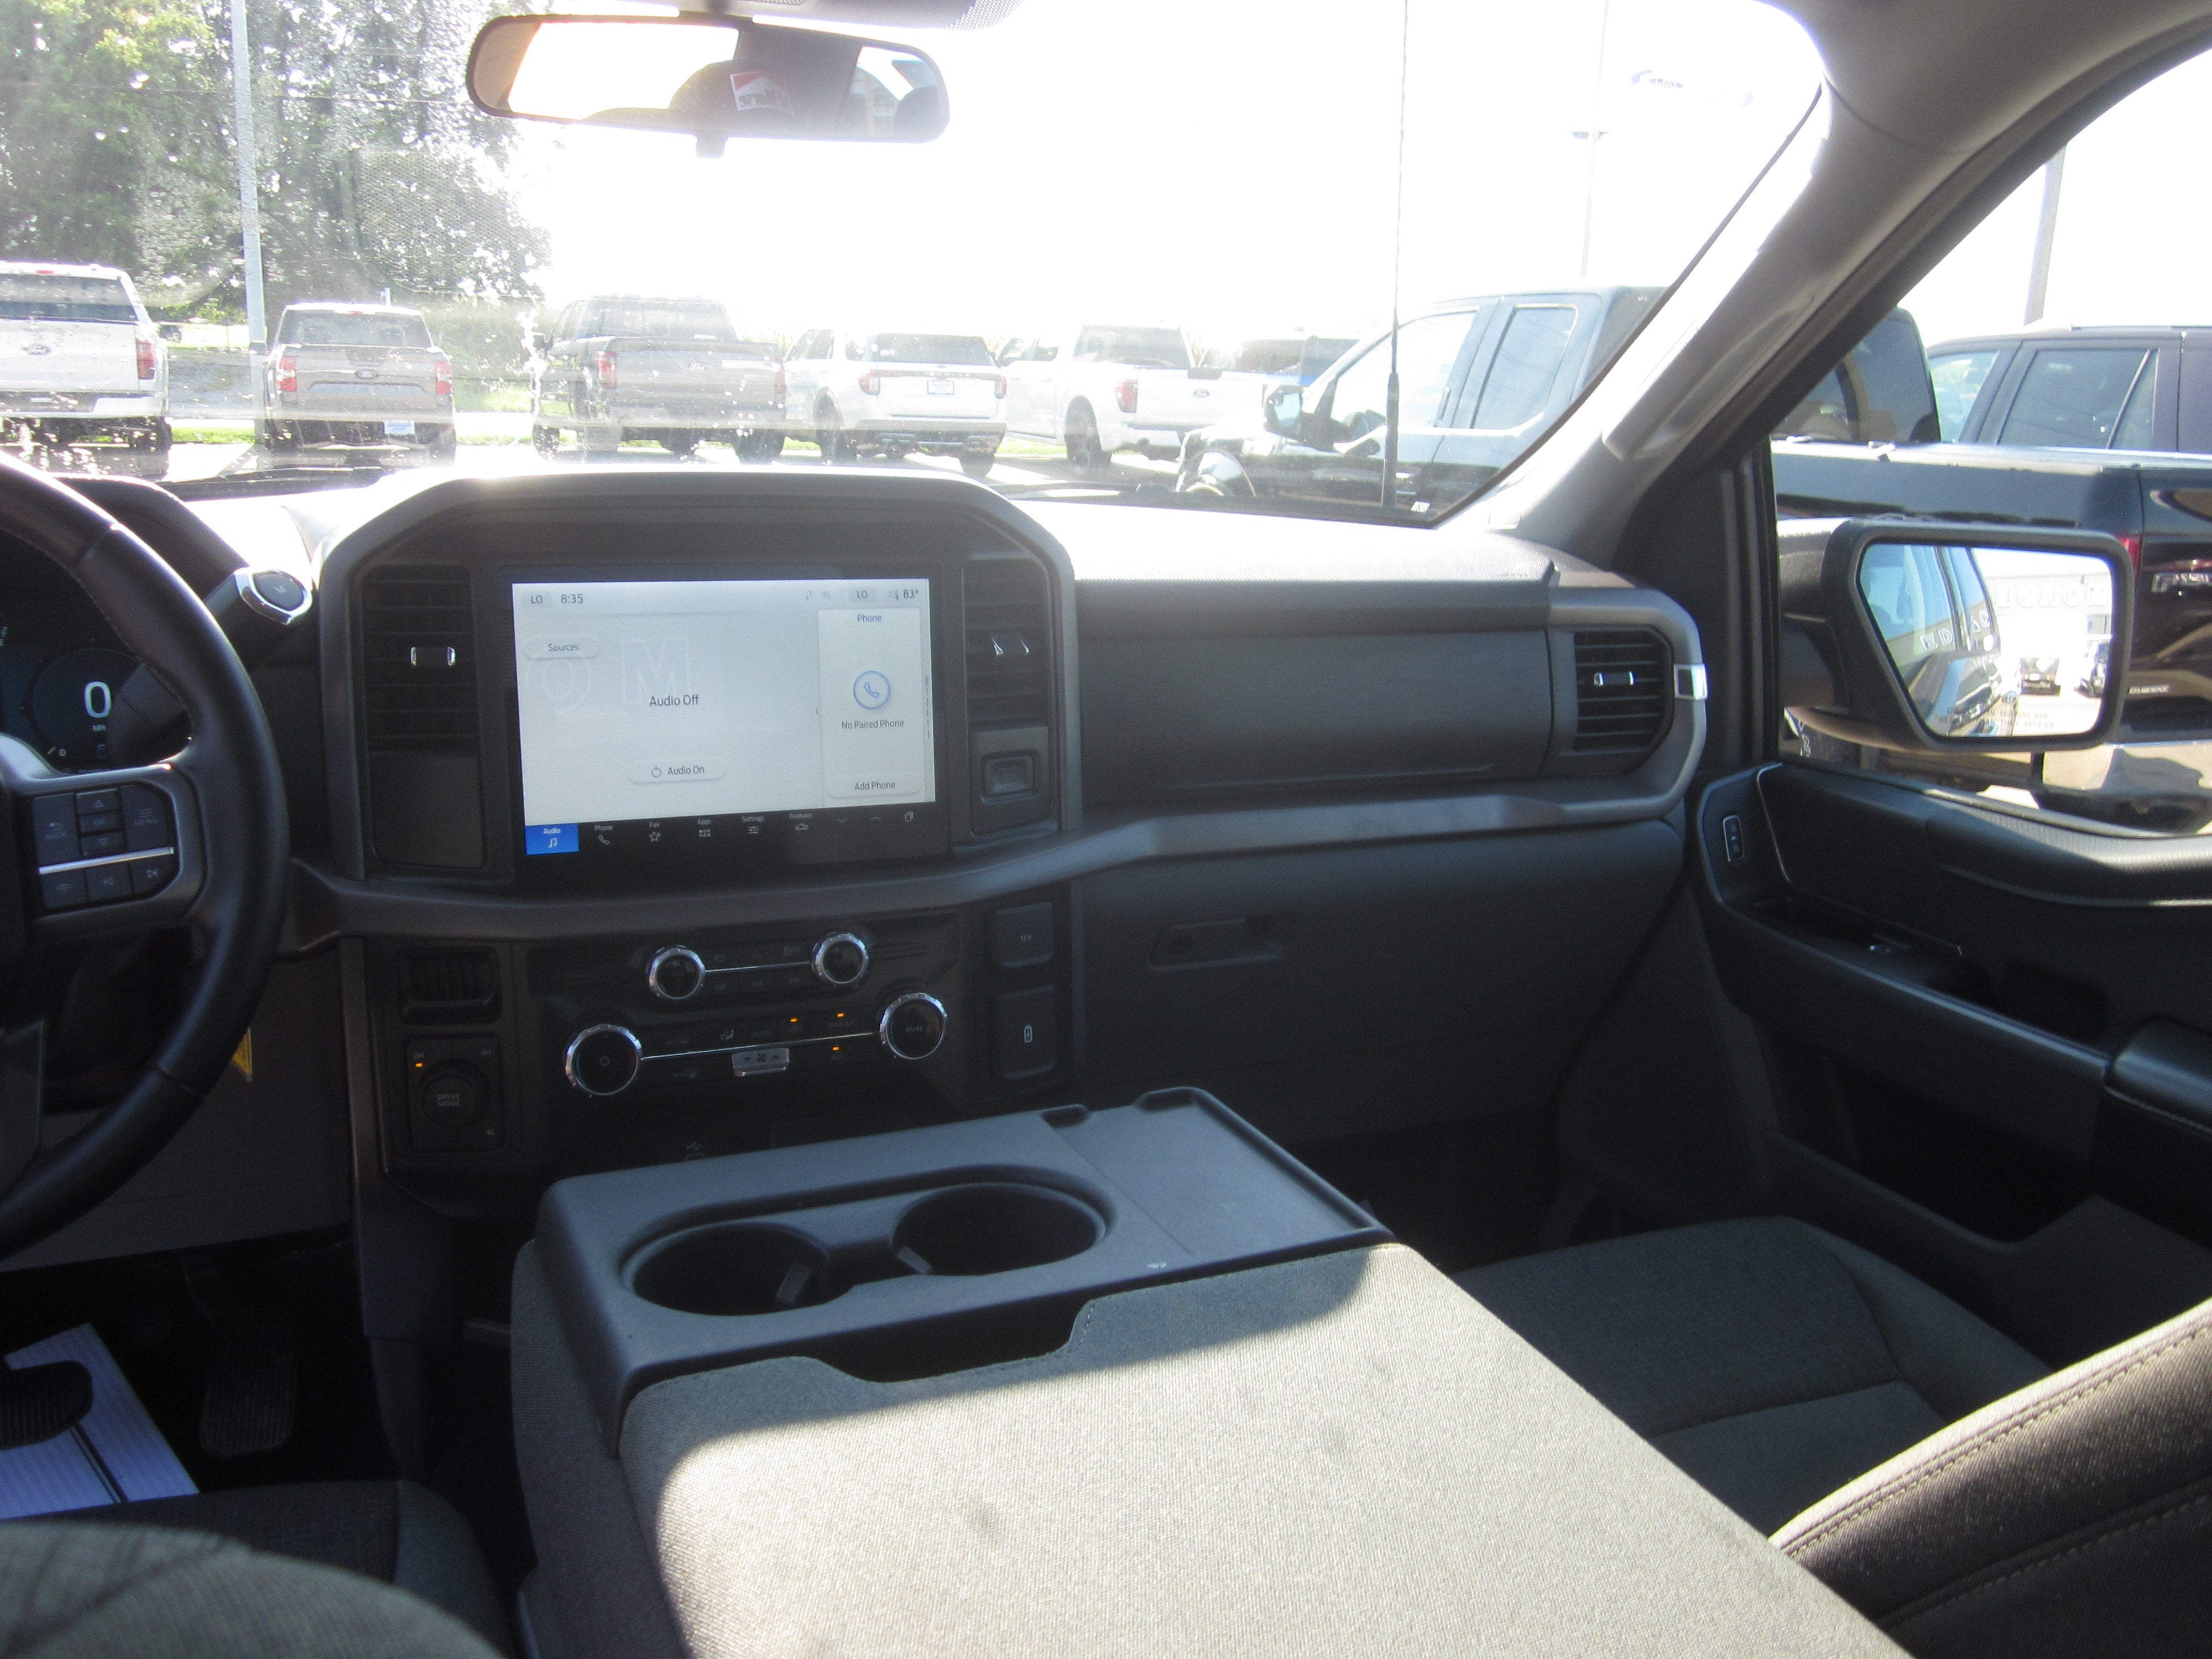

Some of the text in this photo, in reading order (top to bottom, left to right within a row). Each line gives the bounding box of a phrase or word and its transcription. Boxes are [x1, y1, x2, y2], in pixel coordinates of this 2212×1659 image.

[530, 593, 583, 604] LO 8:35
[857, 590, 868, 599] LO
[857, 614, 882, 623] Phone
[547, 643, 579, 652] Sources
[84, 681, 112, 718] 0
[649, 693, 700, 707] Audio Off
[2000, 709, 2030, 718] MIOR
[841, 719, 904, 729] No Paired Phone
[667, 765, 705, 775] Audio On
[854, 781, 895, 790] Add Phone
[741, 815, 765, 823] Settings
[905, 1025, 924, 1033] DUAL
